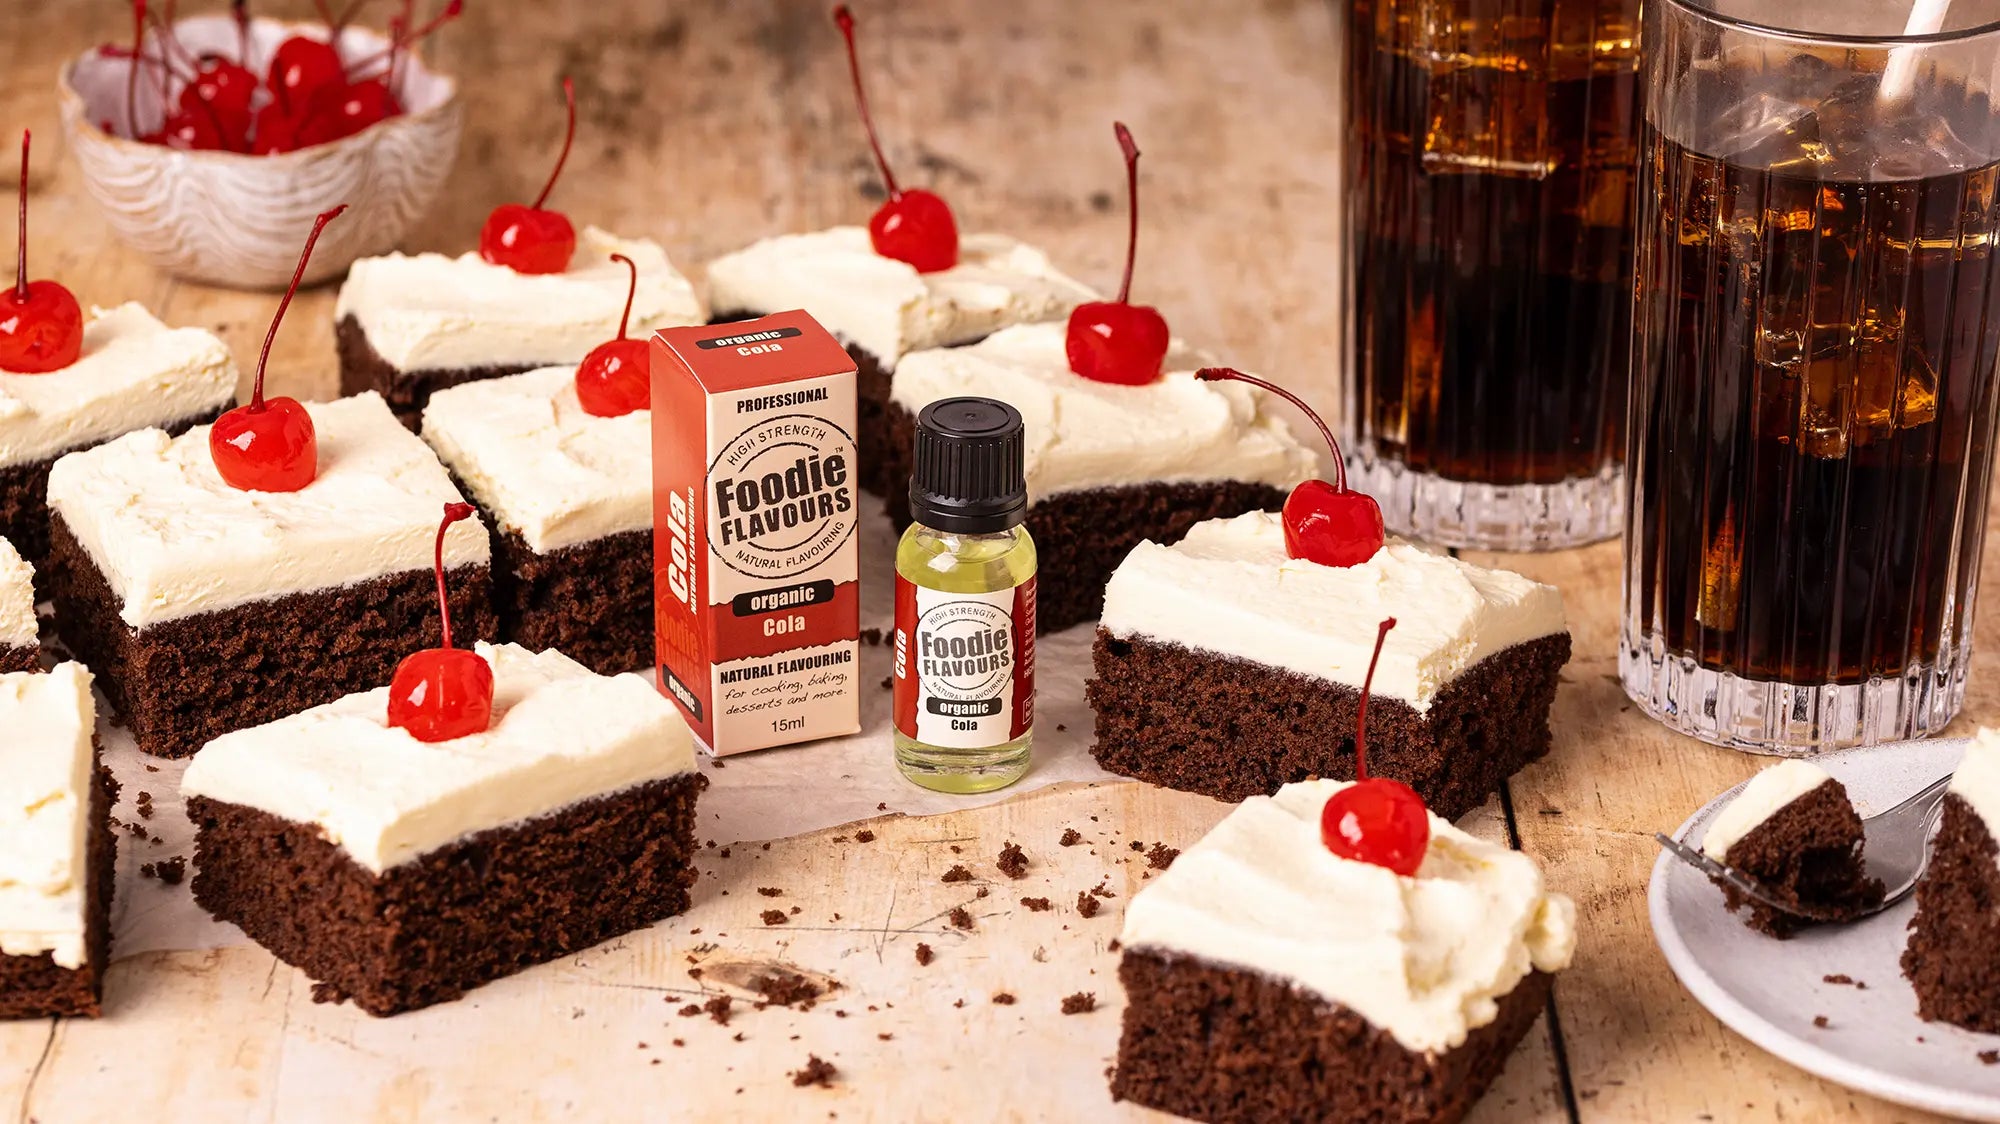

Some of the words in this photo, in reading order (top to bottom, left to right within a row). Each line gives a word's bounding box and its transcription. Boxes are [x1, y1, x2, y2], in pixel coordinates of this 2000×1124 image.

[715, 329, 782, 347] organic
[736, 342, 783, 358] Cola
[737, 387, 829, 414] PROFESSIONAL
[726, 438, 757, 466] HIGH
[758, 424, 827, 443] STRENGTH
[715, 453, 848, 519] Foodie
[688, 486, 696, 562] FLAVOURING
[720, 487, 851, 546] FLAVOURS
[667, 490, 688, 604] Cola
[736, 549, 781, 569] NATURAL
[786, 521, 845, 567] FLAVOURING
[689, 562, 697, 615] NATURAL
[751, 586, 816, 612] organic
[763, 615, 806, 637] Cola
[928, 611, 947, 626] HIGH
[948, 607, 997, 620] STRENGTH
[895, 628, 907, 680] Cola
[921, 628, 1008, 660] Foodie
[720, 664, 775, 685] NATURAL
[777, 650, 852, 675] FLAVOURING
[923, 650, 1010, 678] FLAVOURS
[668, 674, 696, 713] organic
[724, 688, 747, 701] for
[752, 680, 804, 697] cooking,
[808, 671, 848, 687] baking,
[932, 681, 963, 701] NATURAL
[726, 698, 783, 715] desserts
[787, 693, 808, 706] and
[812, 688, 848, 701] more.
[939, 702, 990, 716] organic
[771, 716, 805, 733] 15ml
[951, 719, 978, 731] Cola
